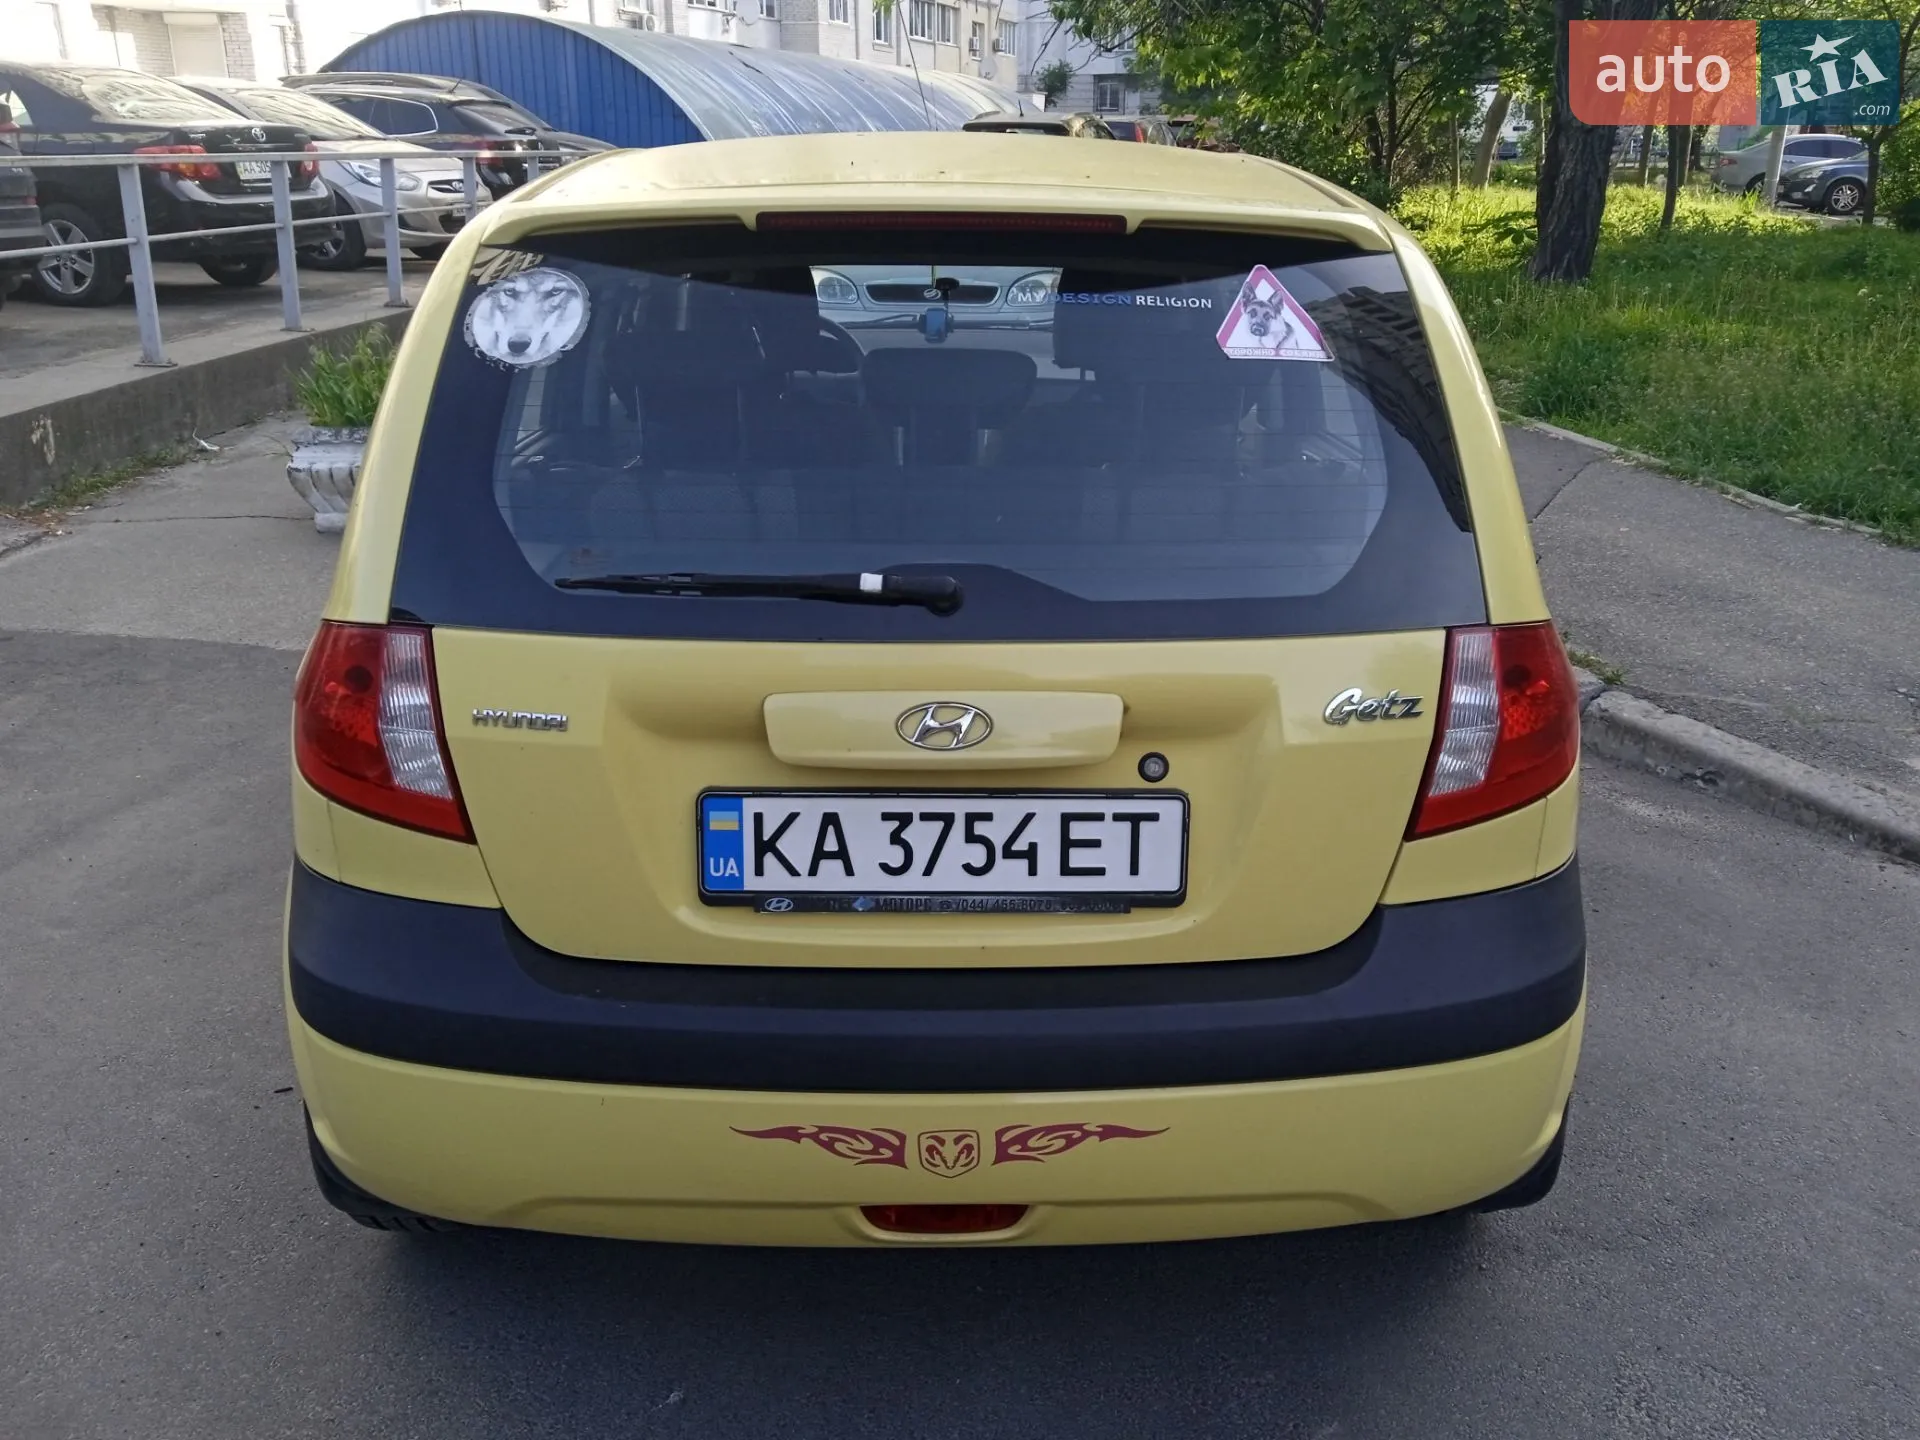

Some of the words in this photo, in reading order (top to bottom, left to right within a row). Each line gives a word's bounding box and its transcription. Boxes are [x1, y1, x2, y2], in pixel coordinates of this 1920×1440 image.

[1017, 290, 1045, 303] MY
[1049, 292, 1132, 305] DESIGN
[1135, 294, 1212, 309] RELIGION
[1323, 687, 1424, 726] Getz
[472, 708, 568, 732] HYUNDAI
[753, 811, 855, 877] KA
[877, 811, 1038, 877] 3754
[1060, 811, 1160, 877] ET
[709, 857, 740, 878] UA
